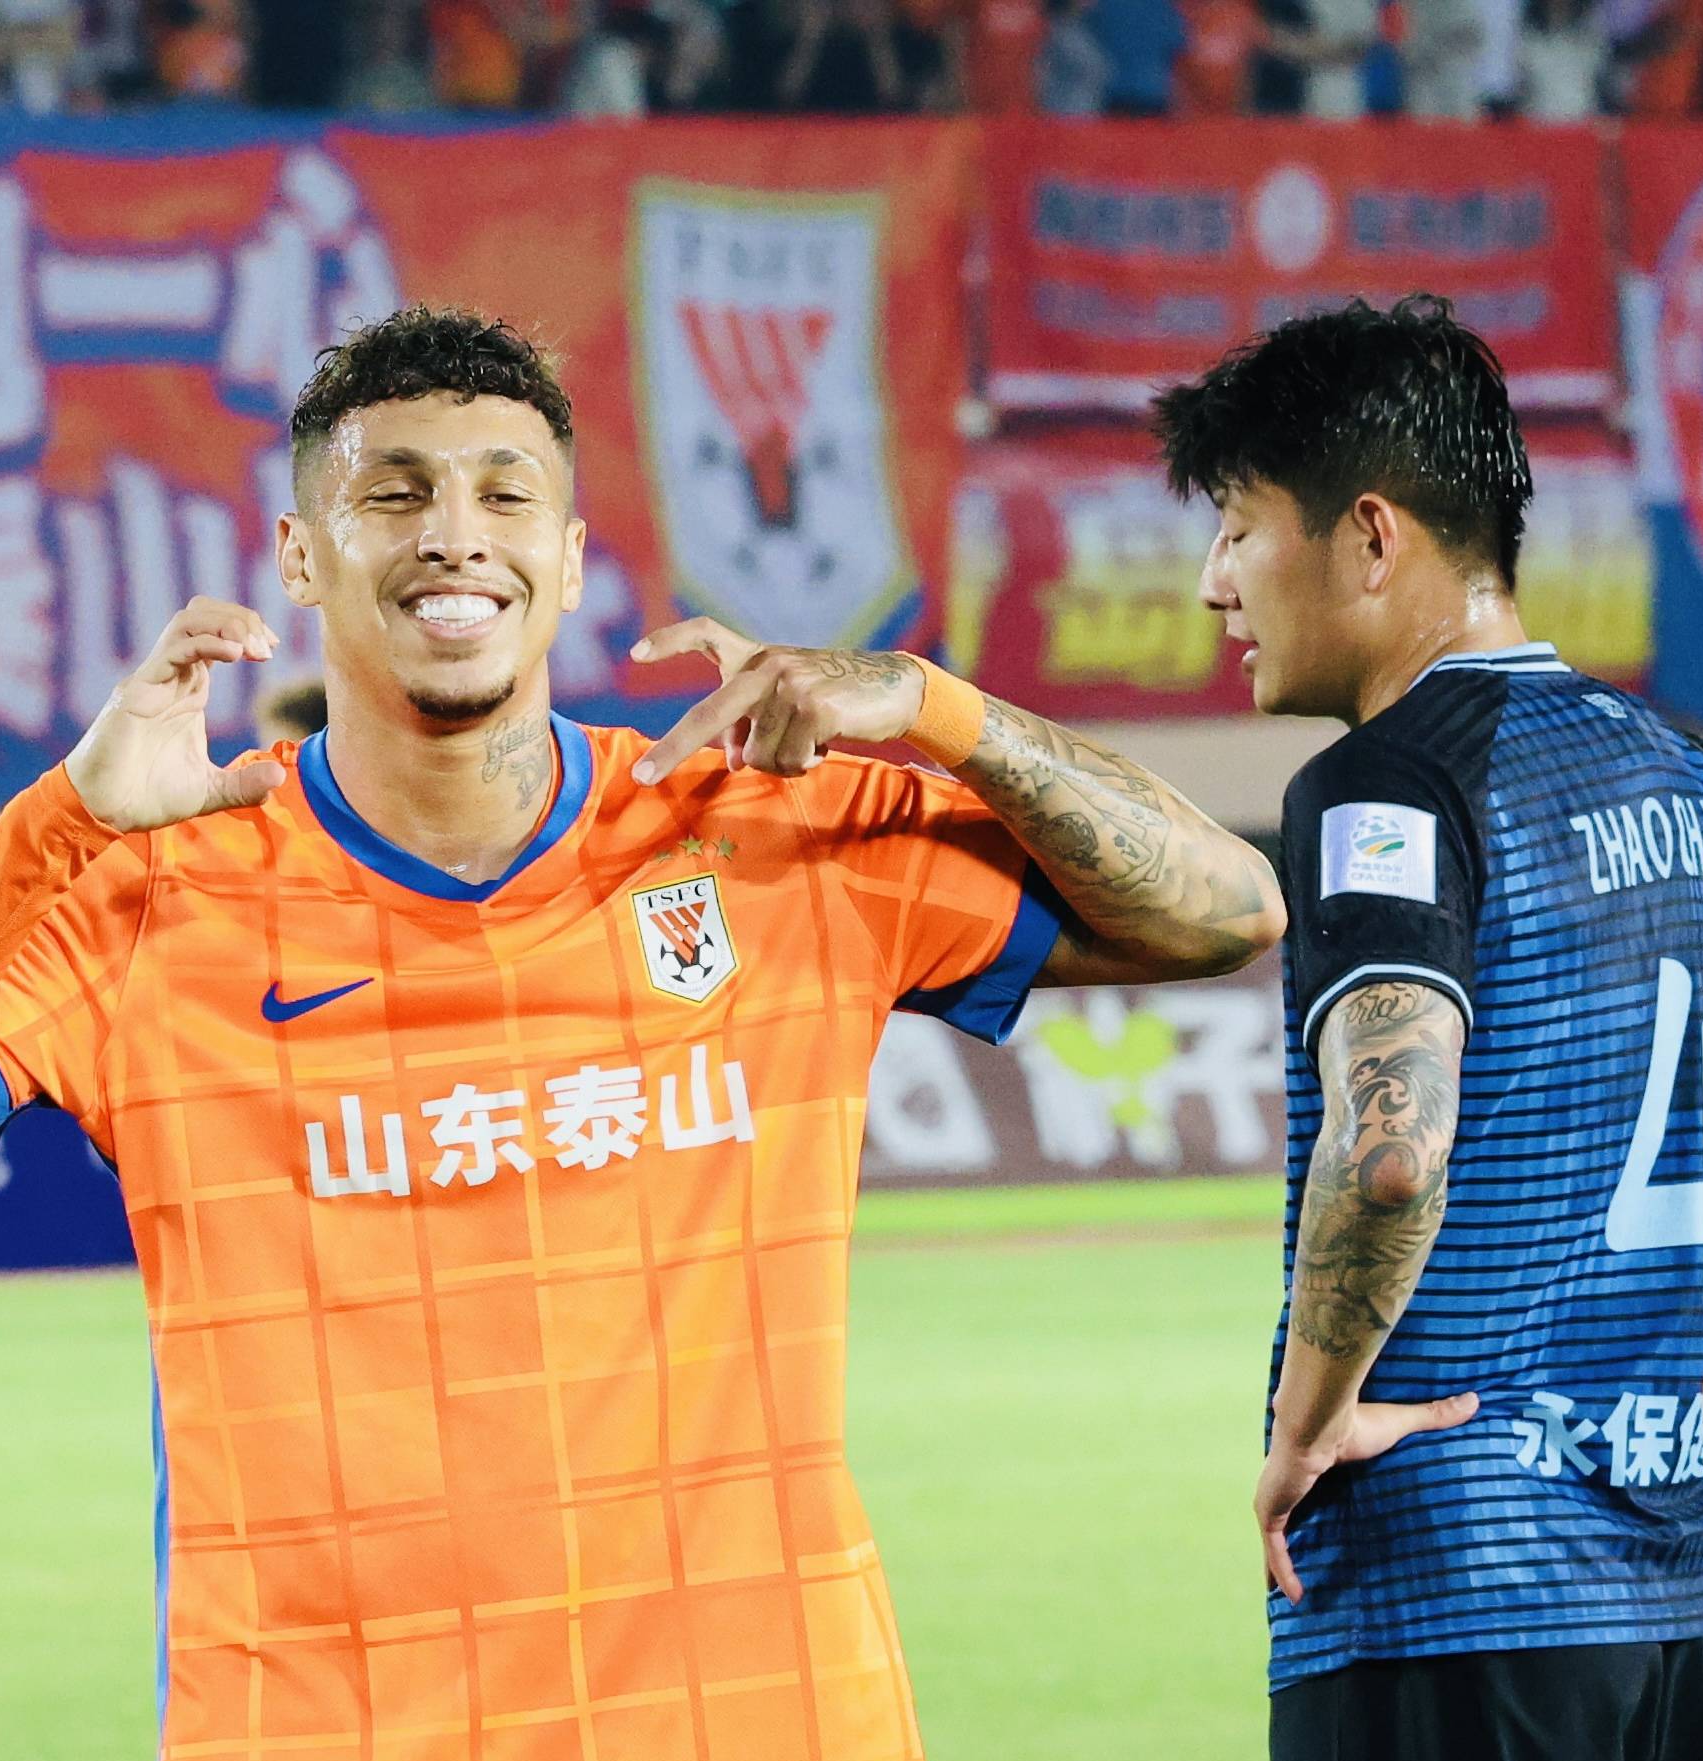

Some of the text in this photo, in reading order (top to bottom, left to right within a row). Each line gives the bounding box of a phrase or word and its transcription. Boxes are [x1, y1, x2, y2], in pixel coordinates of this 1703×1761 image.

[1569, 797, 1674, 894] ZHAO
[642, 883, 707, 909] TSFC
[305, 1043, 756, 1199] 山东泰山
